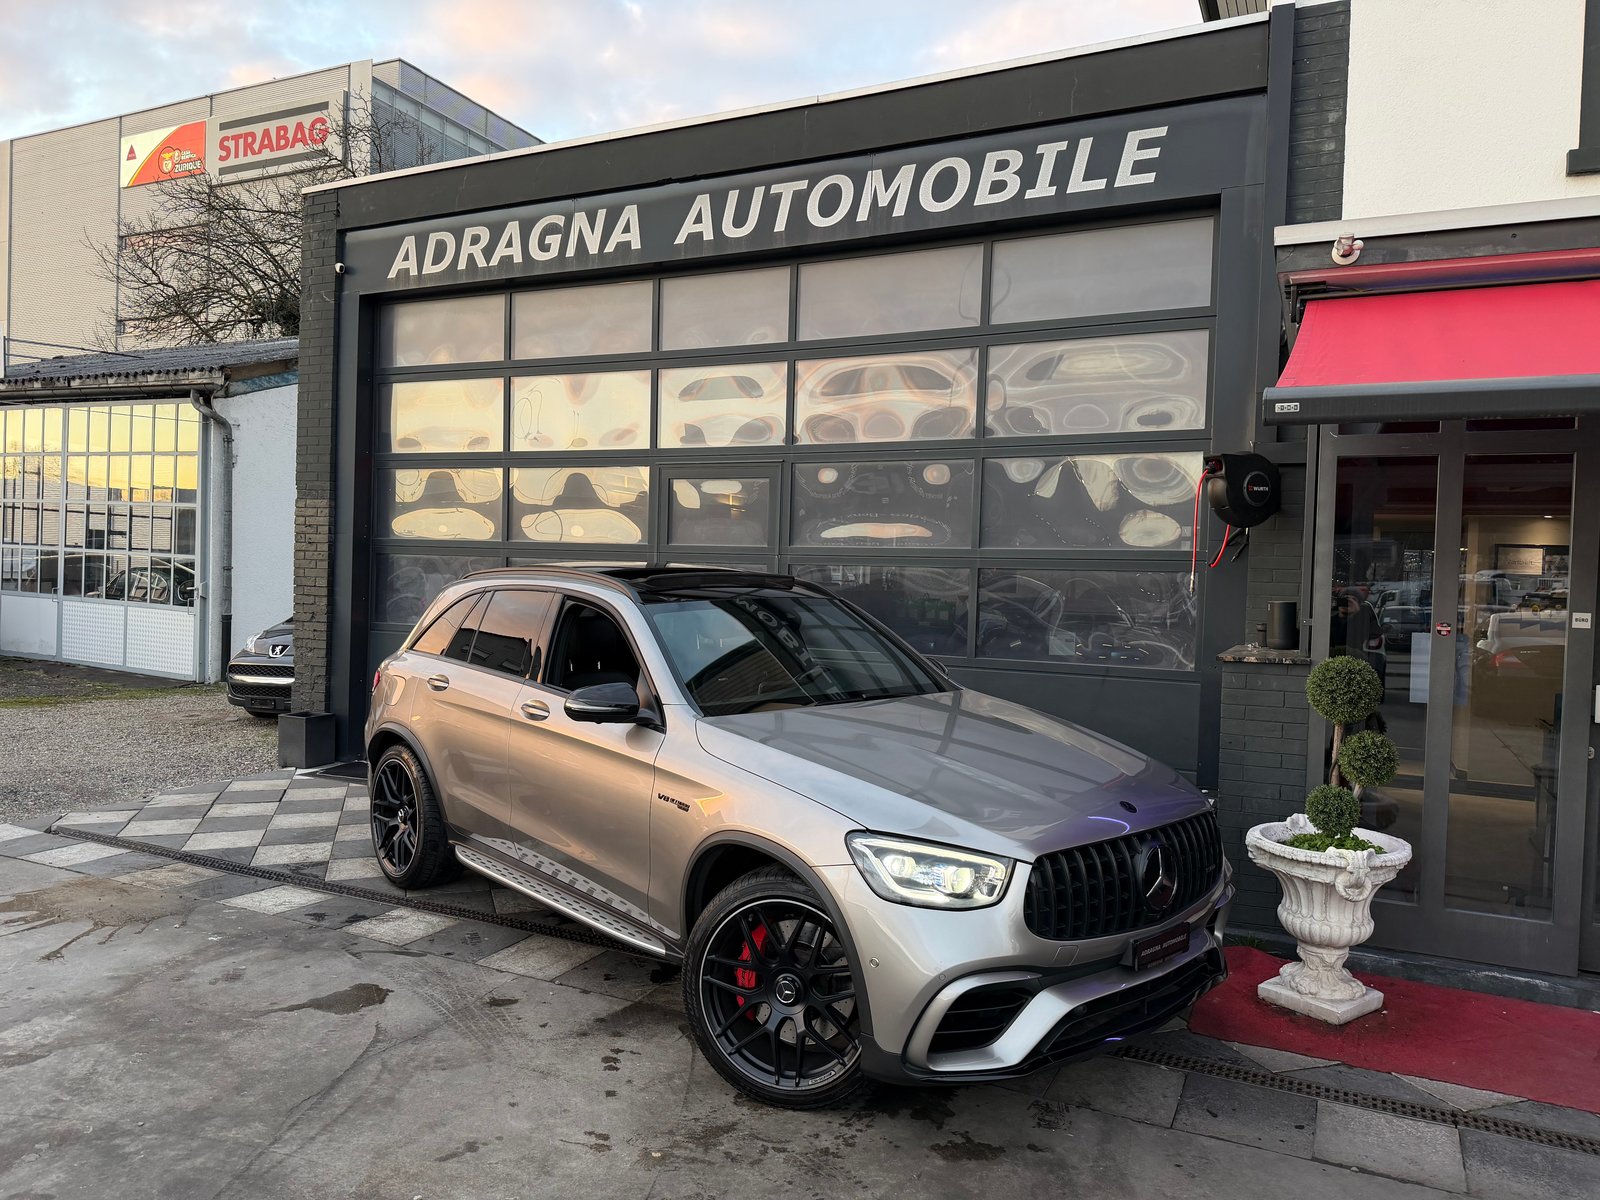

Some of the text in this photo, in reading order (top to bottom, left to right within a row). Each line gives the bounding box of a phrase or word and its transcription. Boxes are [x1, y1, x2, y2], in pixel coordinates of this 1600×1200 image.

[218, 117, 329, 161] STRABAG
[174, 160, 202, 173] ZURIQUE
[387, 125, 1169, 280] ADRAGNA AUTOMOBILE
[1141, 945, 1160, 956] ADRAGNA
